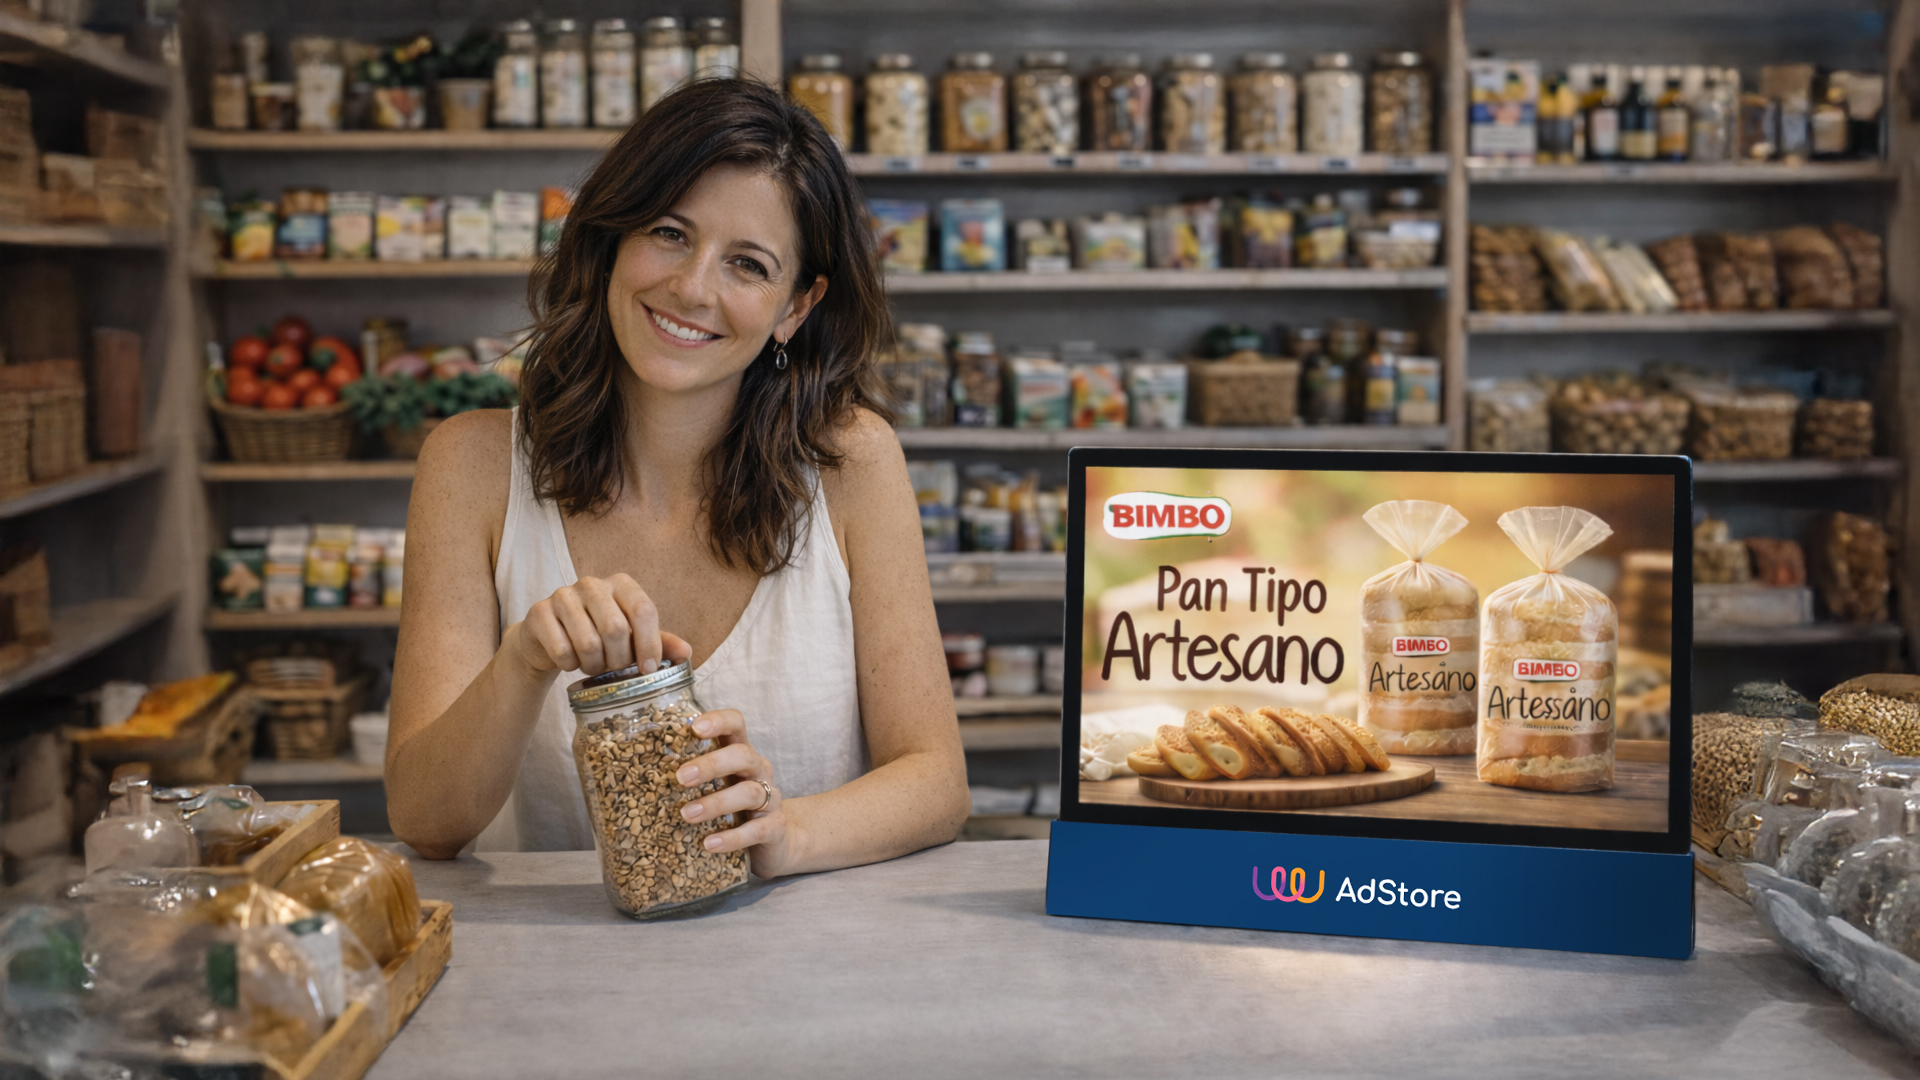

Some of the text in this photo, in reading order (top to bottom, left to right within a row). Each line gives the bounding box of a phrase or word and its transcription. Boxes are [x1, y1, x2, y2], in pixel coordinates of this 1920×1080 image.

[1110, 504, 1225, 529] BIMBO
[1157, 565, 1327, 627] Pan Tipo
[1101, 610, 1345, 685] Artesano
[1335, 877, 1462, 910] AdStore
